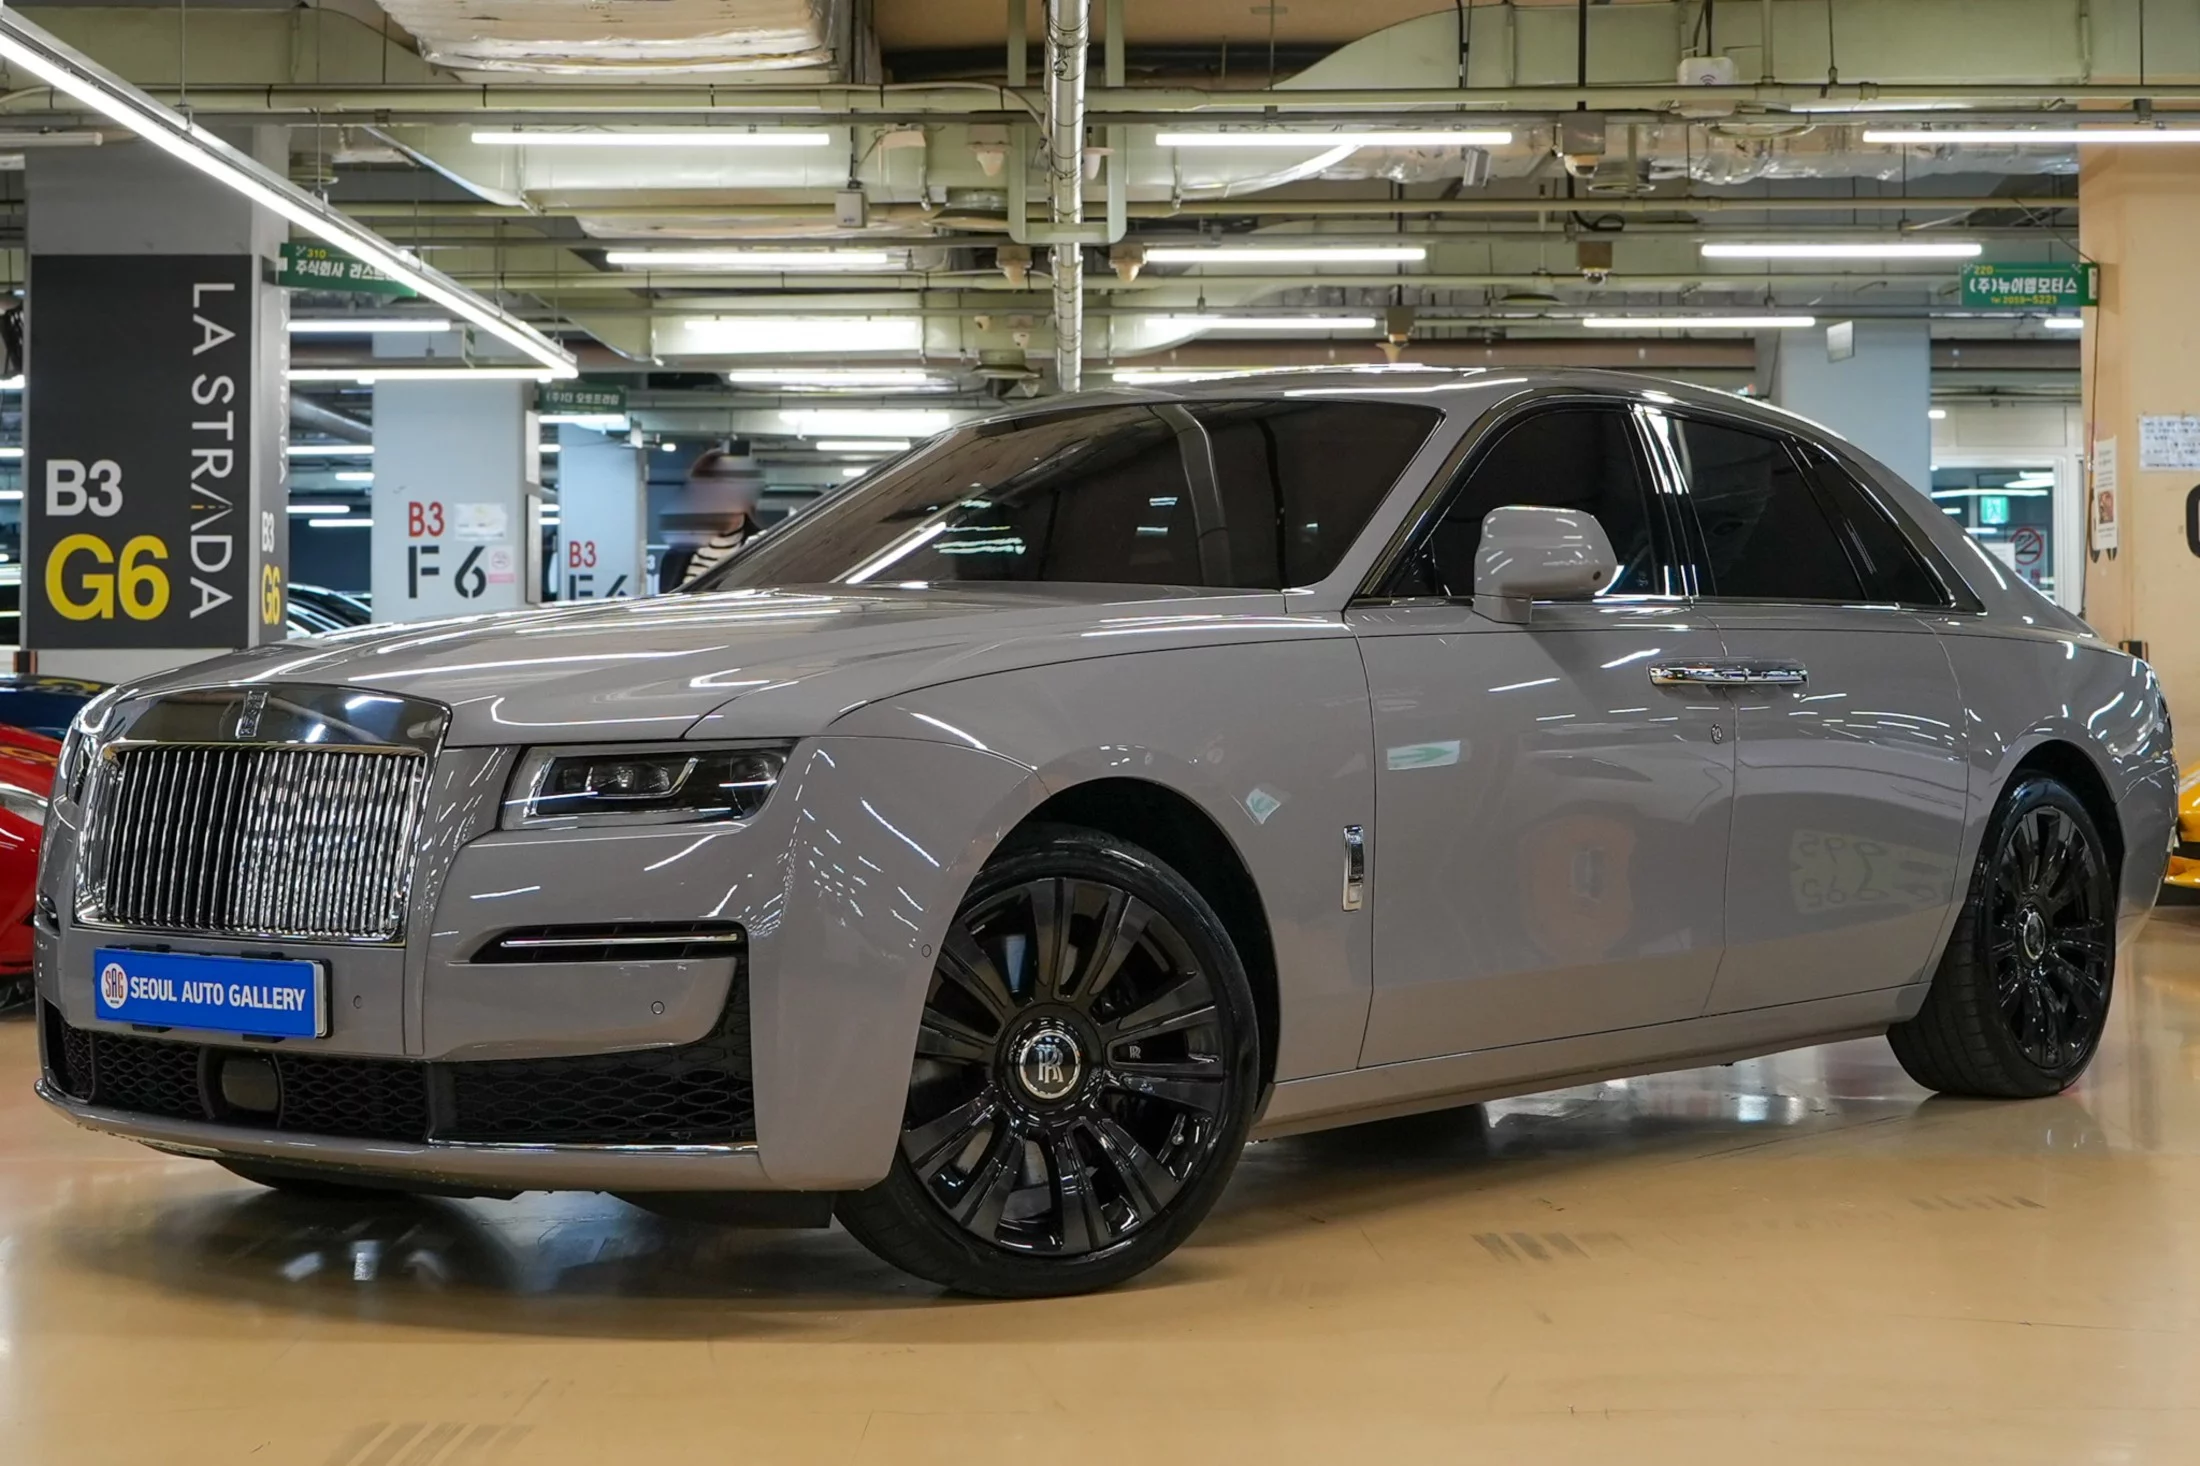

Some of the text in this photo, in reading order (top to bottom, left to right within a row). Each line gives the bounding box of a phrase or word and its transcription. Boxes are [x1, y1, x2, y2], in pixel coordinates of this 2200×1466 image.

[296, 260, 344, 277] 주식회사
[307, 249, 327, 259] 310
[189, 283, 235, 619] LA STRADA
[46, 459, 123, 517] B3
[262, 511, 275, 552] B3
[408, 501, 446, 538] B3
[569, 541, 596, 568] B3
[45, 533, 171, 622] G6
[262, 564, 281, 625] G6
[105, 967, 306, 1011] SAG SEOUL AUTO GALLERY
